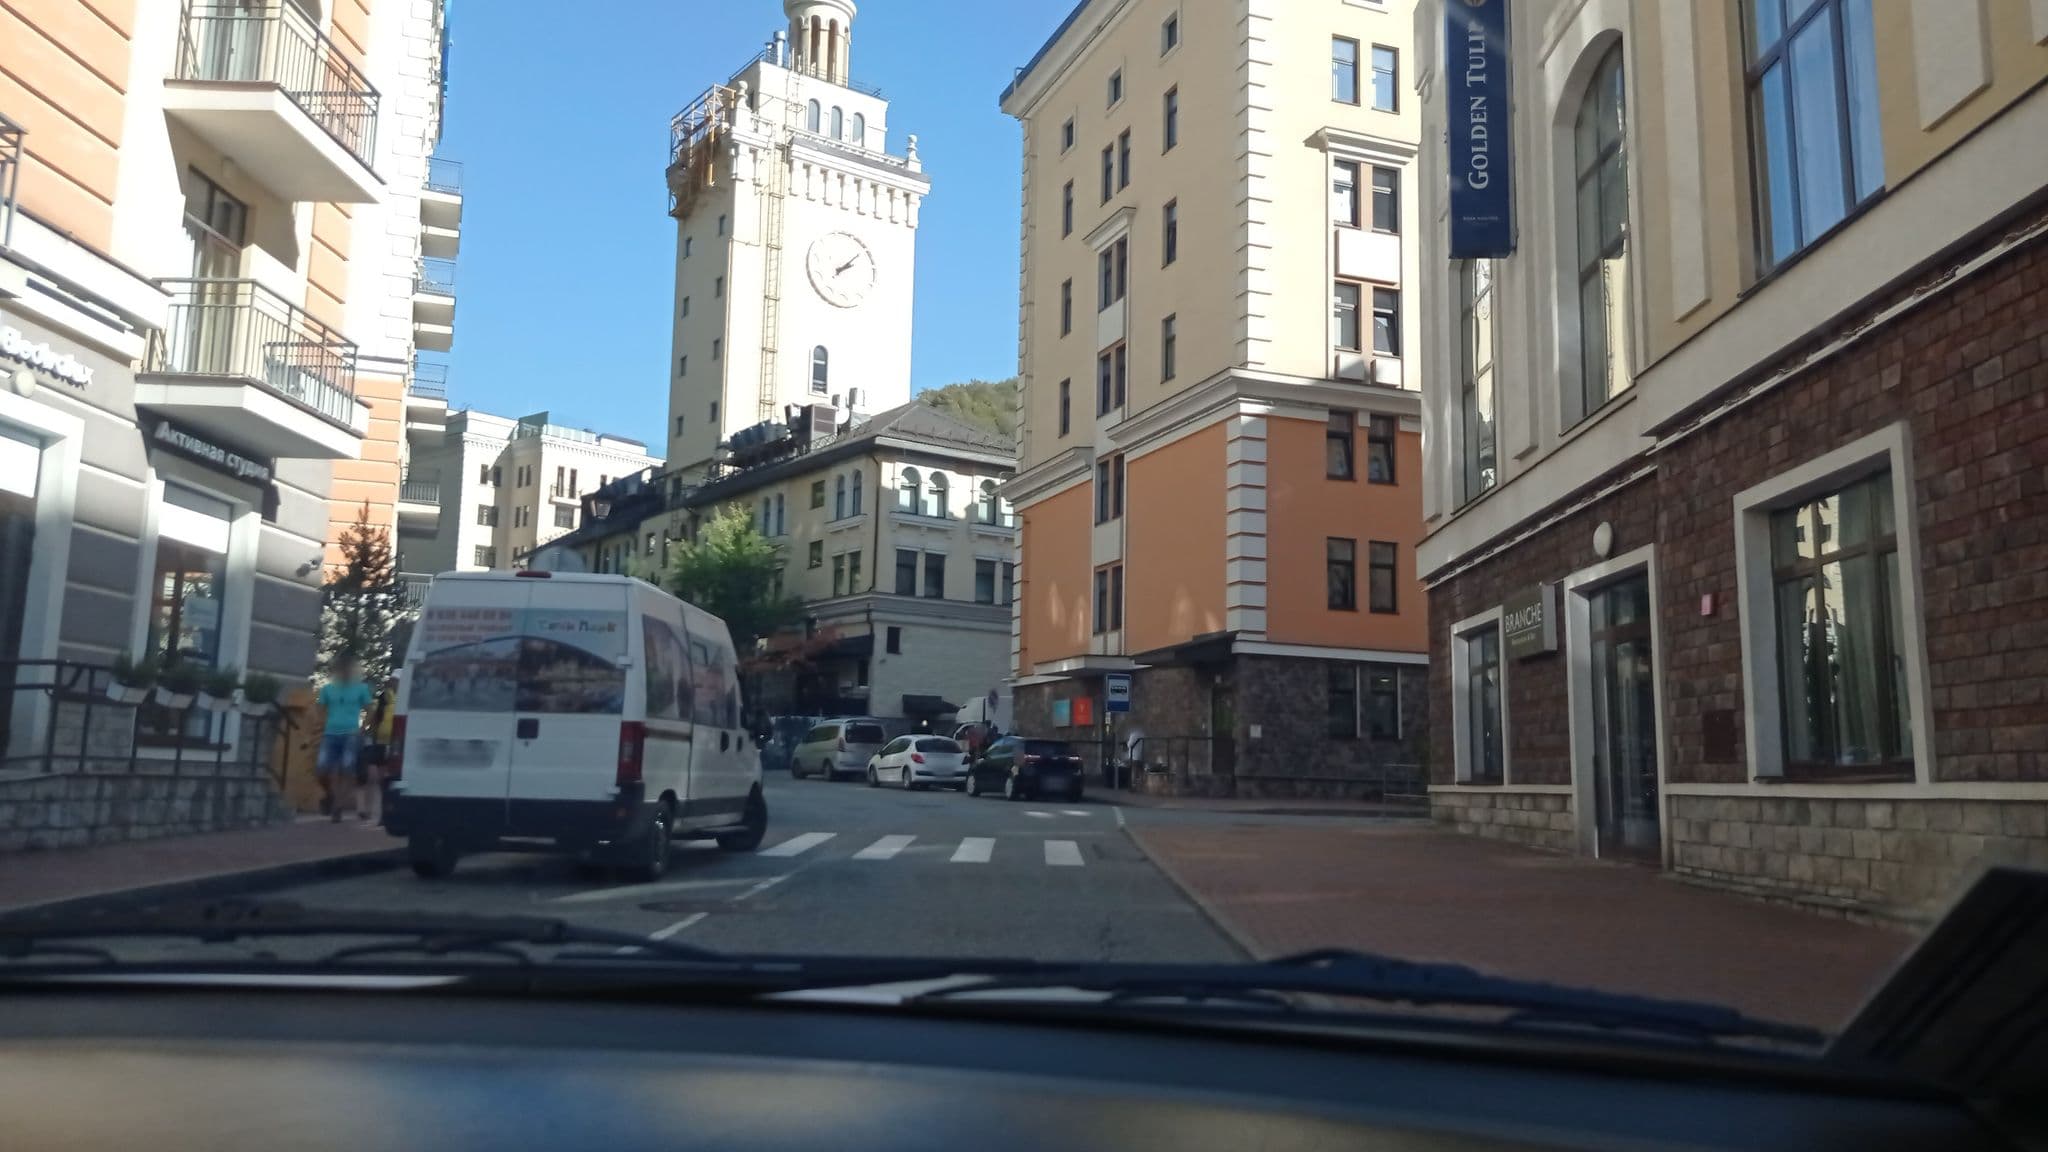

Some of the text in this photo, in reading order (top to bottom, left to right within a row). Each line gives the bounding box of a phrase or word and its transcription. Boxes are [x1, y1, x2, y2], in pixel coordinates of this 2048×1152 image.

[1465, 19, 1488, 88] TULIP
[1467, 95, 1490, 190] GOLDEN
[154, 421, 270, 481] Активная студия
[1504, 602, 1542, 633] BRANCHE
